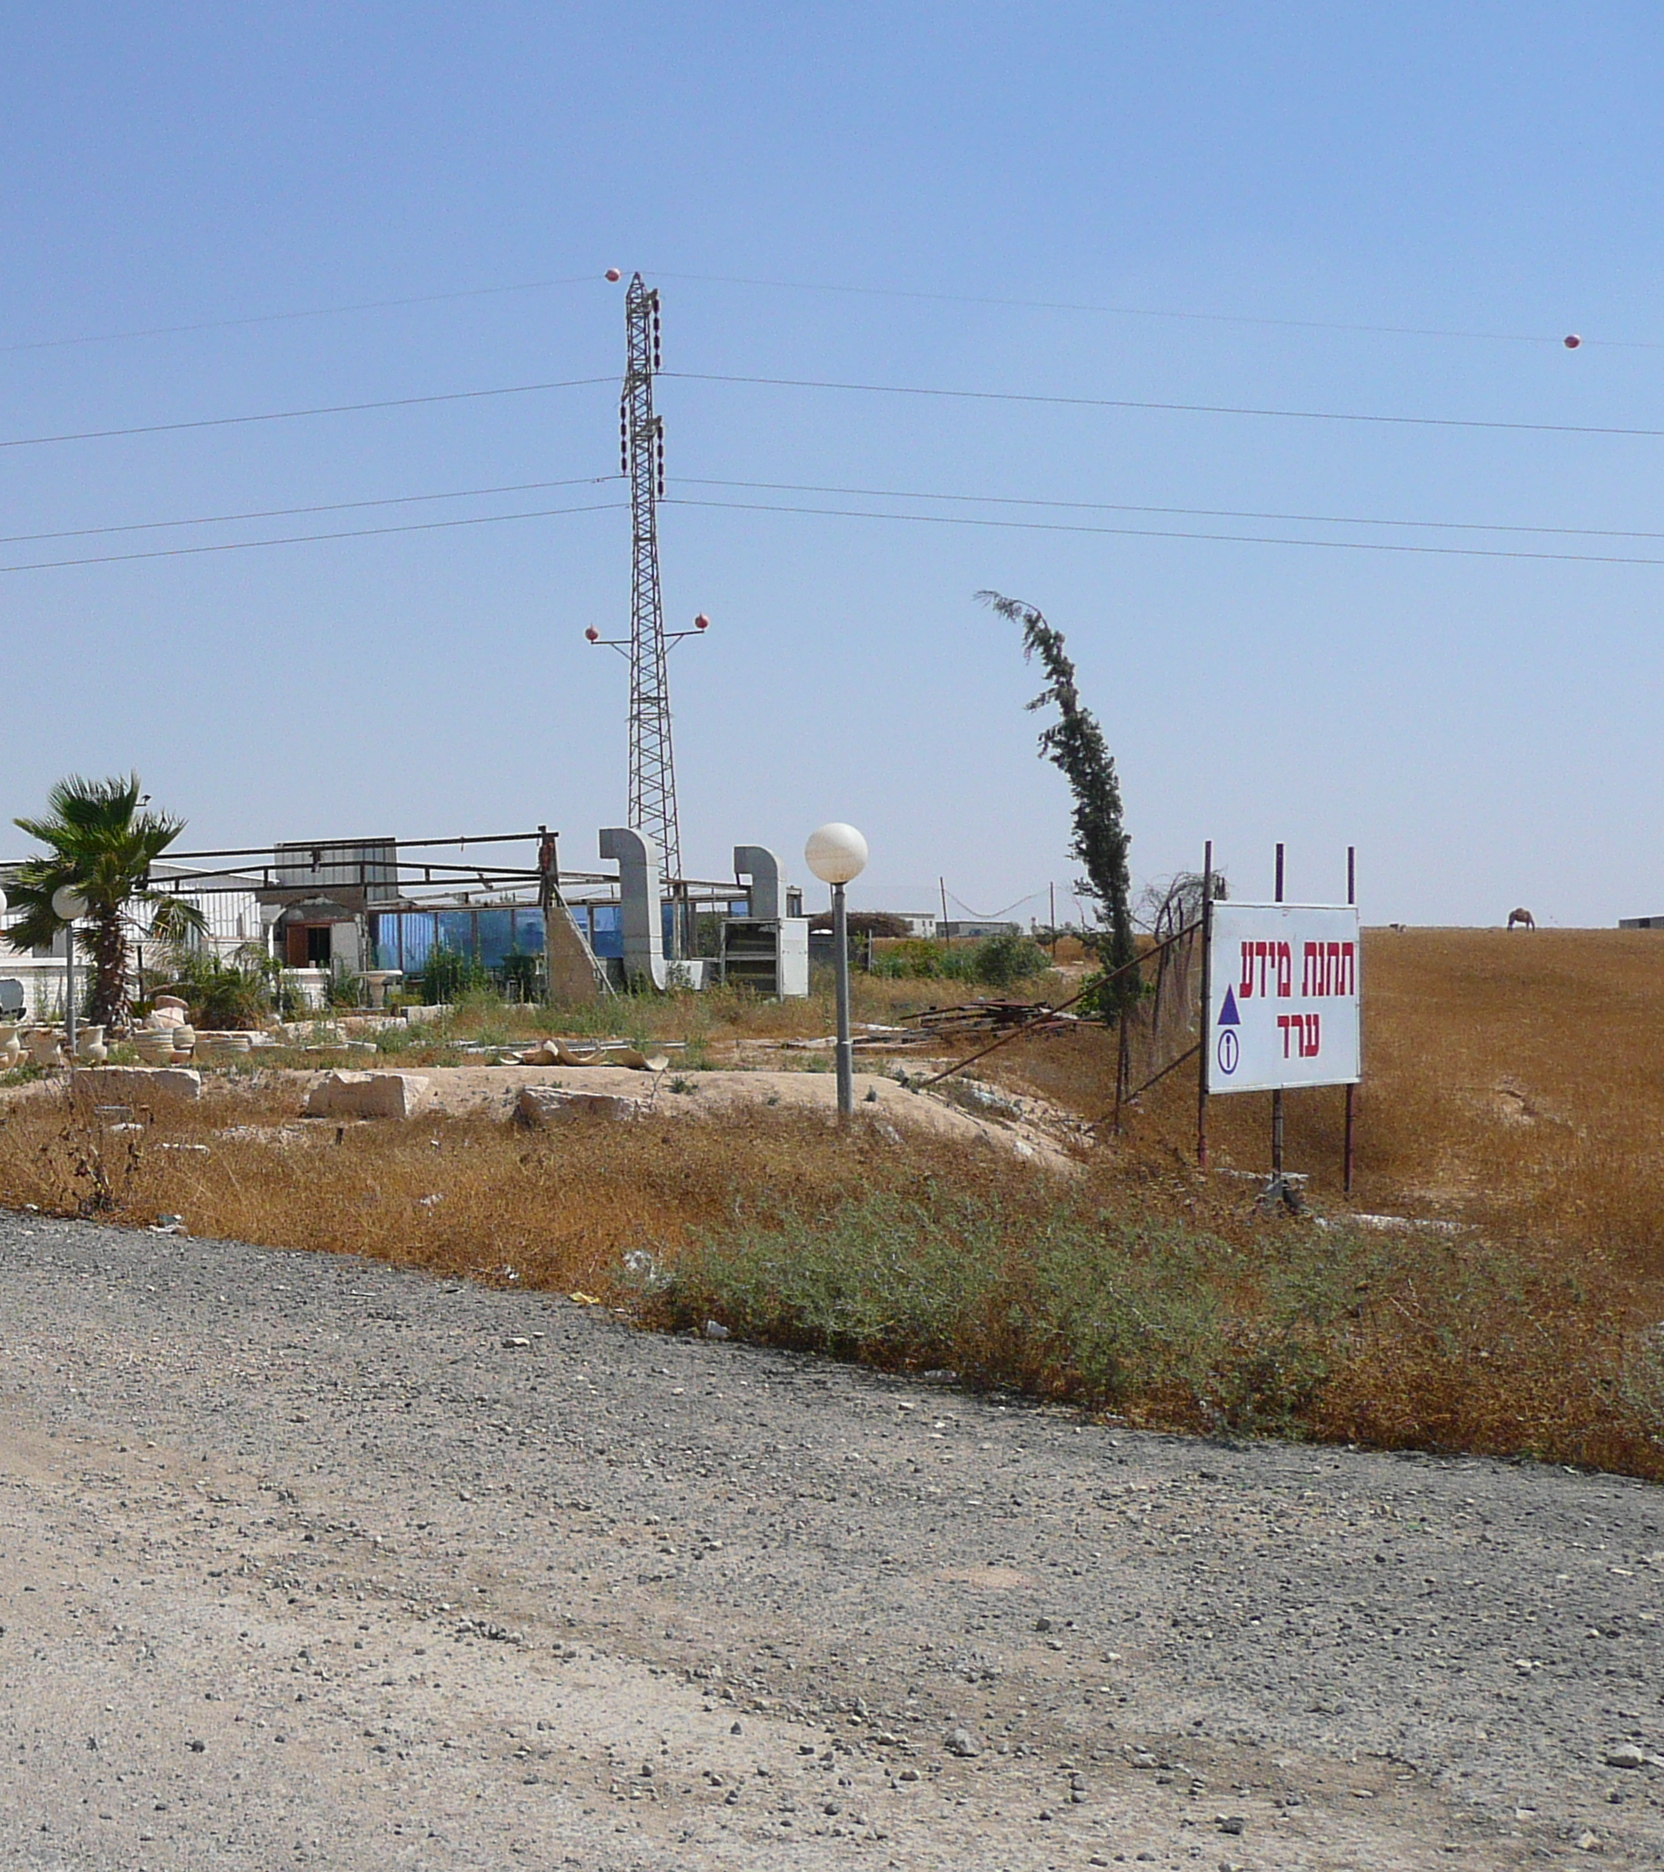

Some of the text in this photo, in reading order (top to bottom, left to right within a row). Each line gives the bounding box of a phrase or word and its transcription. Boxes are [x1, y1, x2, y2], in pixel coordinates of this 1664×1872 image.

[1239, 941, 1354, 998] תחנת מידע
[1277, 1014, 1319, 1059] ערד
